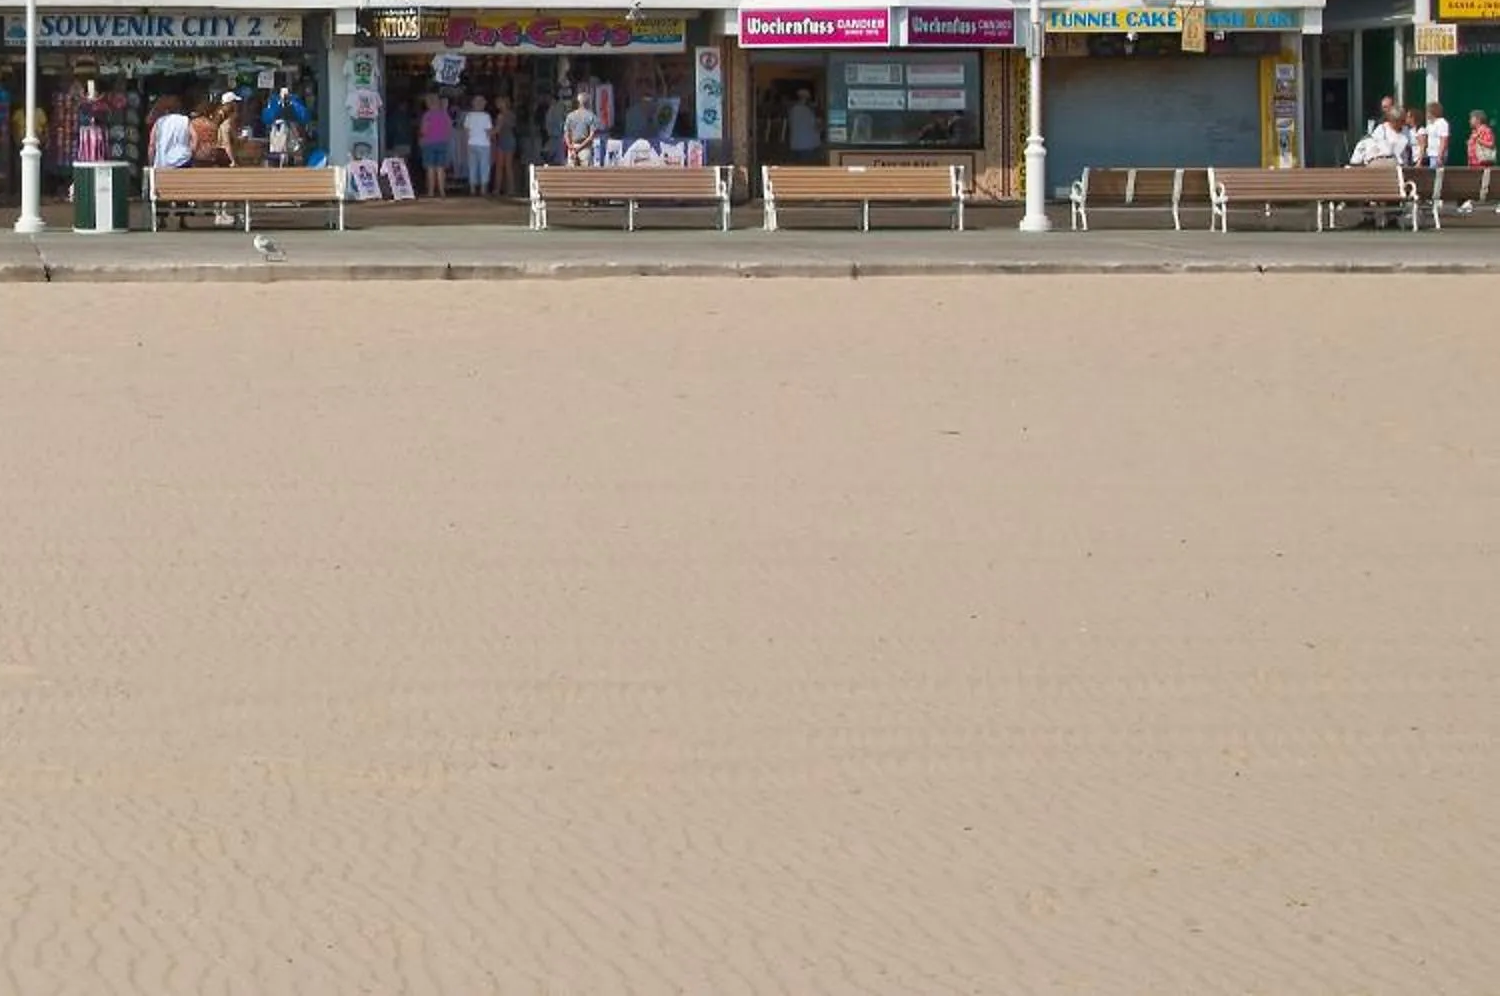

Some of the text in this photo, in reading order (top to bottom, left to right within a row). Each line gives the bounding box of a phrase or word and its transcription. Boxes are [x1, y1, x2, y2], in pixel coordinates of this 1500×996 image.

[40, 15, 262, 37] SOUVENIR CITY 2
[747, 17, 885, 35] Wockenfuss CANDIES
[1051, 11, 1177, 27] FUNNEL CAKE
